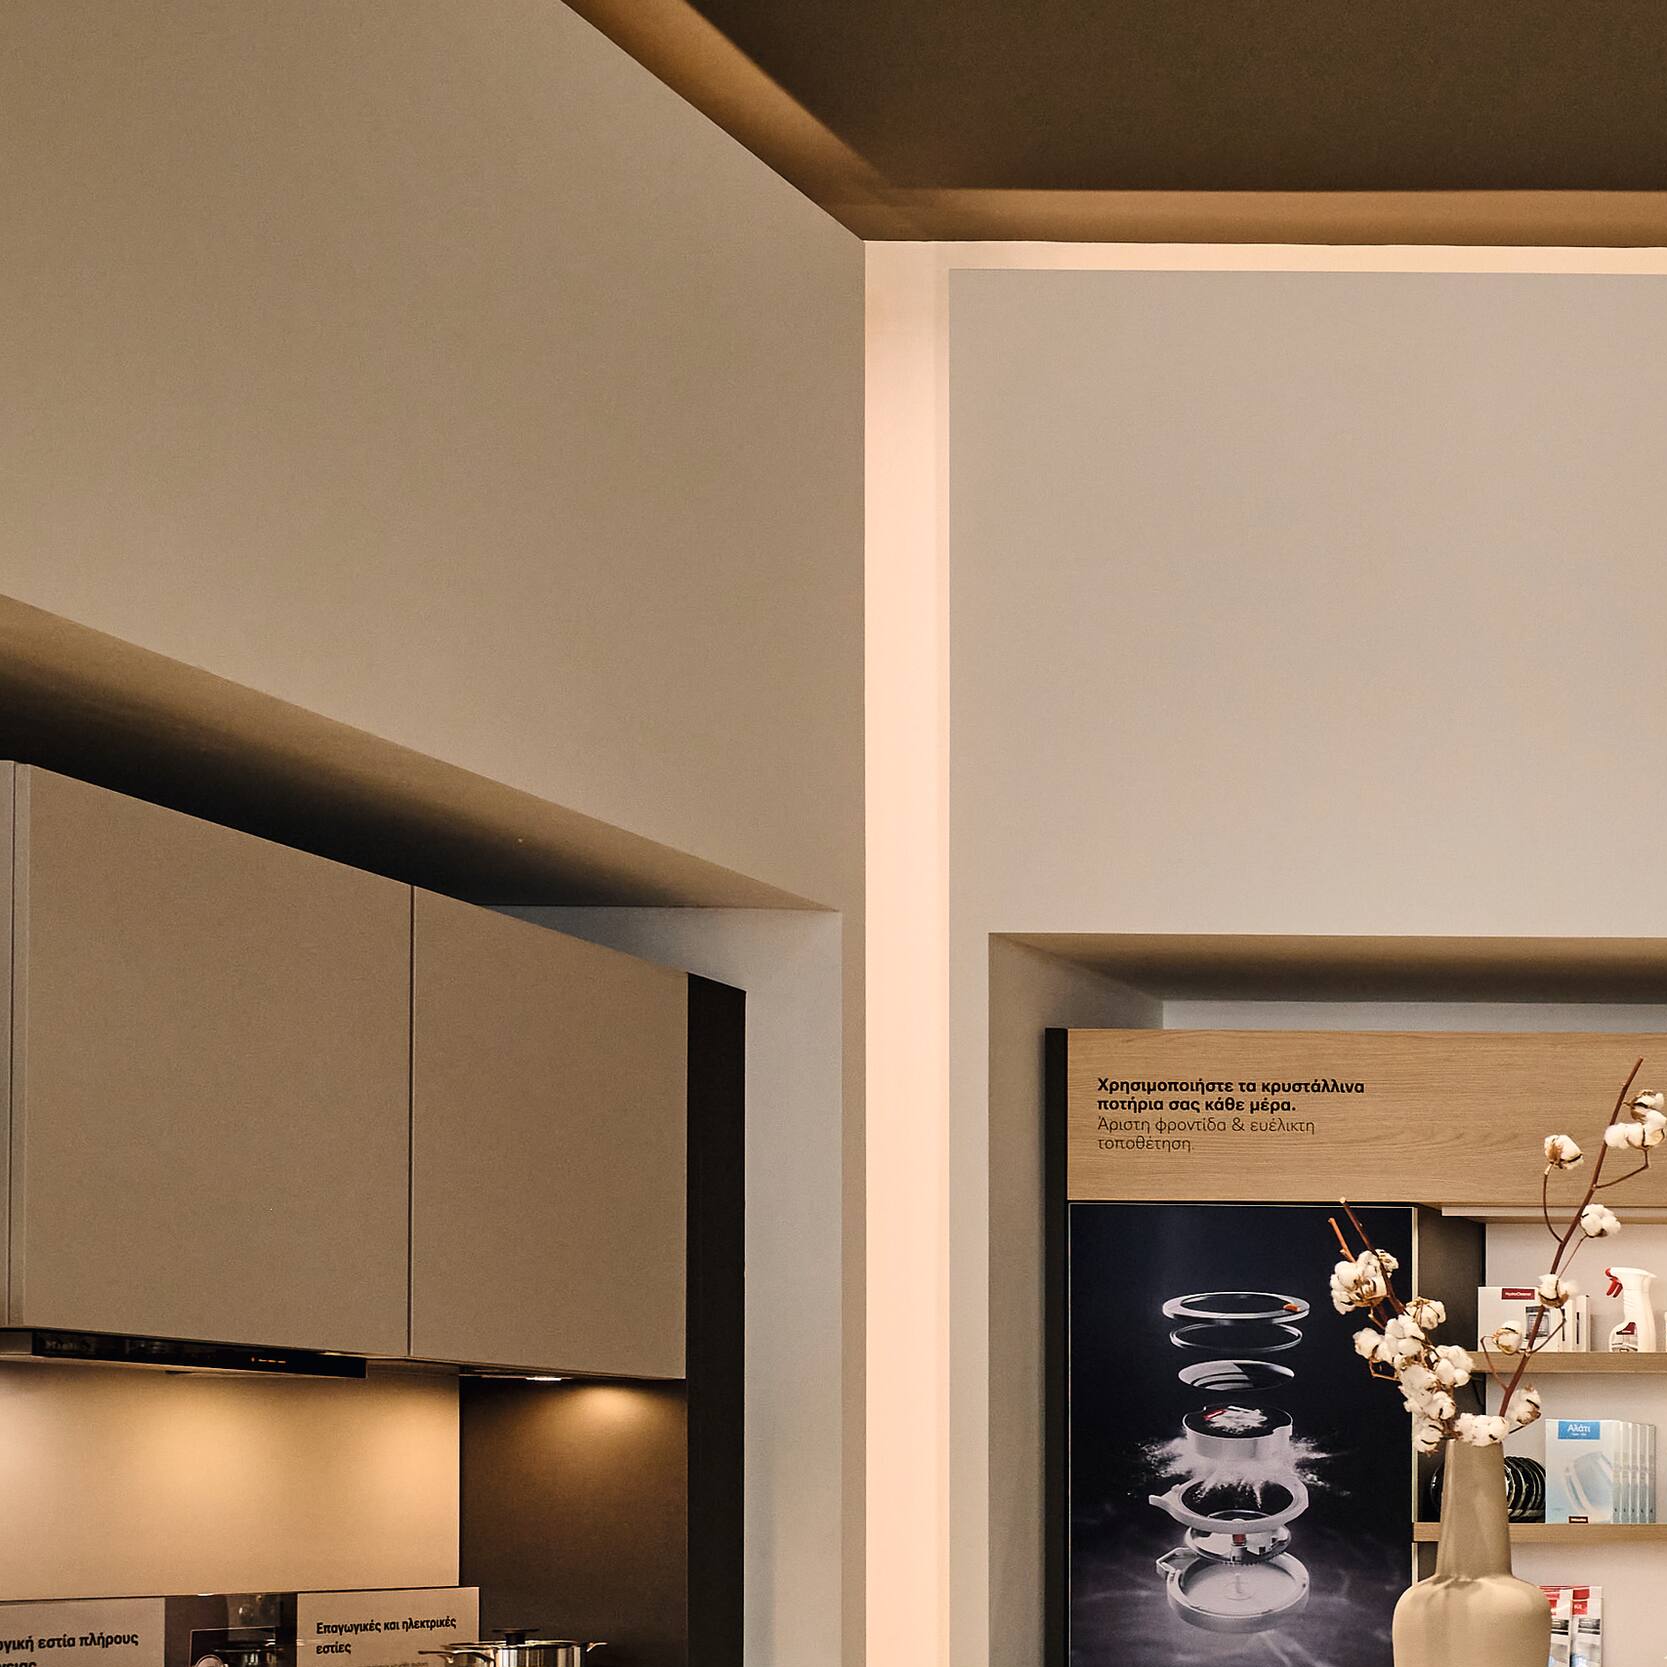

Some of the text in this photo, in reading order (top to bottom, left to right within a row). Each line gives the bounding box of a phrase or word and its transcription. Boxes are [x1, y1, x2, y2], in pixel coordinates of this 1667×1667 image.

[1097, 1077, 1365, 1096] Χρησιμοποιήστε τα κρυστάλλινα
[1097, 1096, 1297, 1115] ποτήρια σας κάθε μέρα.
[1097, 1115, 1315, 1134] Άριστη φροντίδα & ευέλικτη
[316, 1616, 457, 1636] Επαγωγικές και ηλεκτρικές
[0, 1631, 139, 1654] γική εστία πλήρους
[316, 1642, 351, 1655] εστίες
